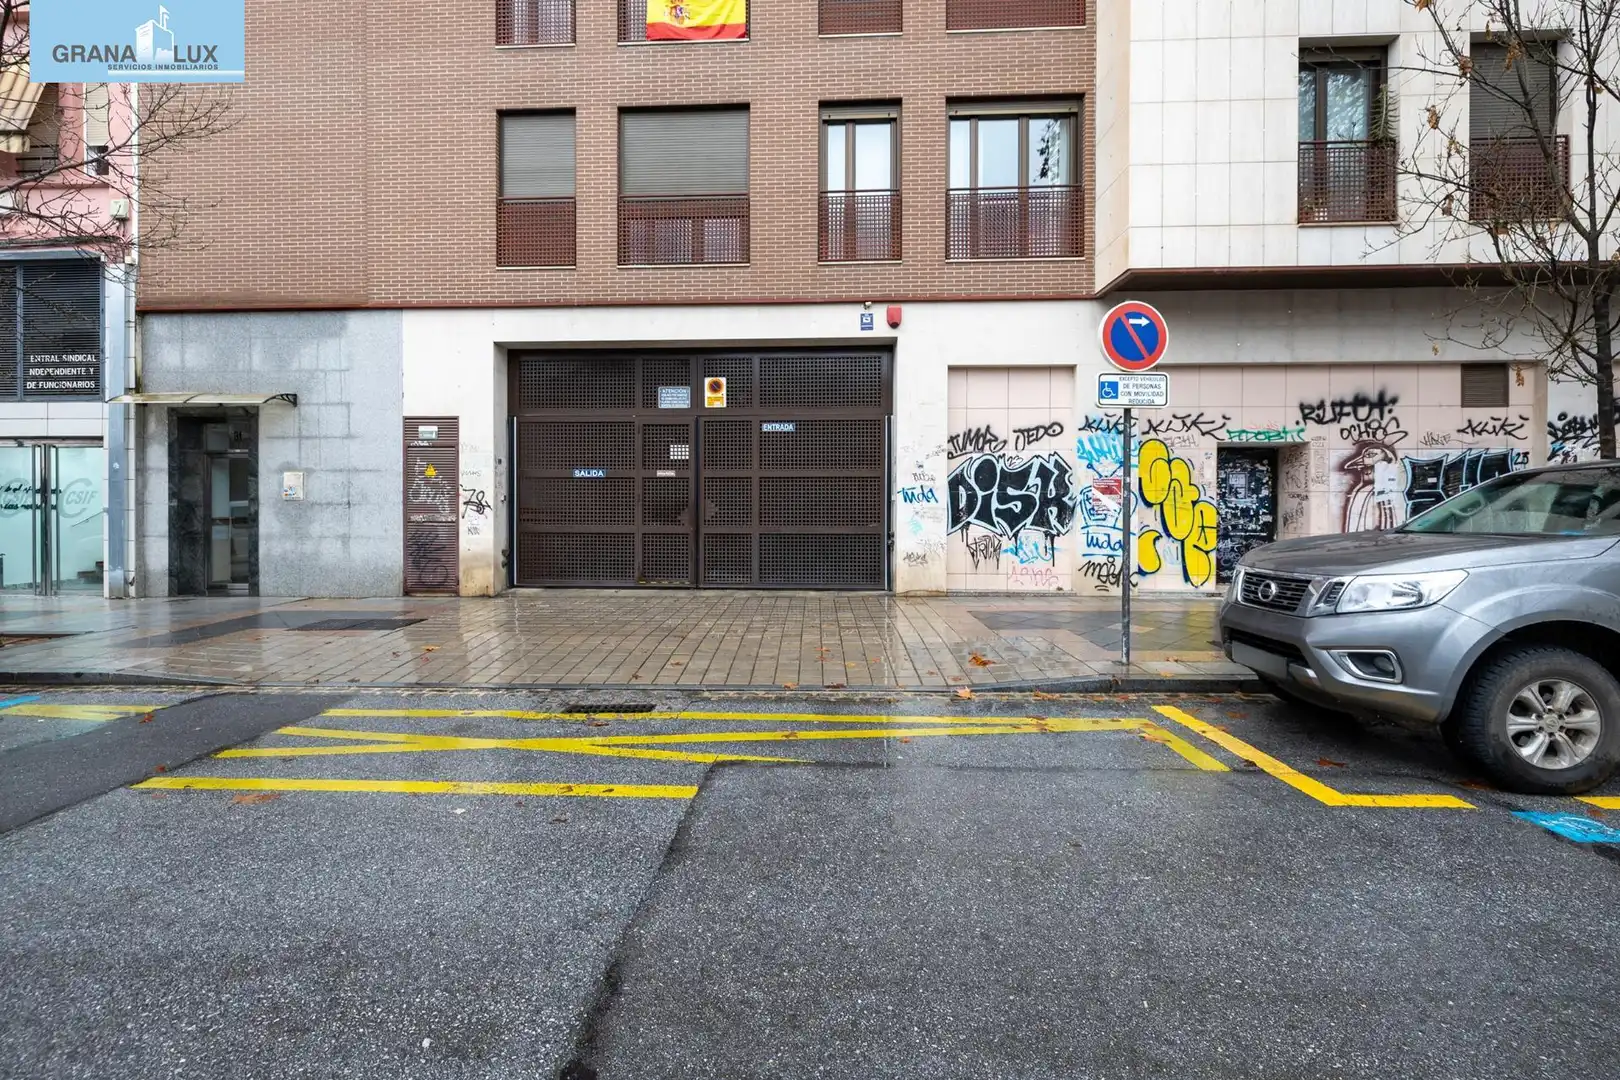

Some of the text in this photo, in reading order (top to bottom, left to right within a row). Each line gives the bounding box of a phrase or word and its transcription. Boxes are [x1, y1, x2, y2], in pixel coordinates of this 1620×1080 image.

[62, 354, 97, 362] SINDICAL
[89, 367, 94, 375] Y
[26, 380, 95, 389] DE FUNCIONARIOS
[65, 491, 97, 505] CSIF
